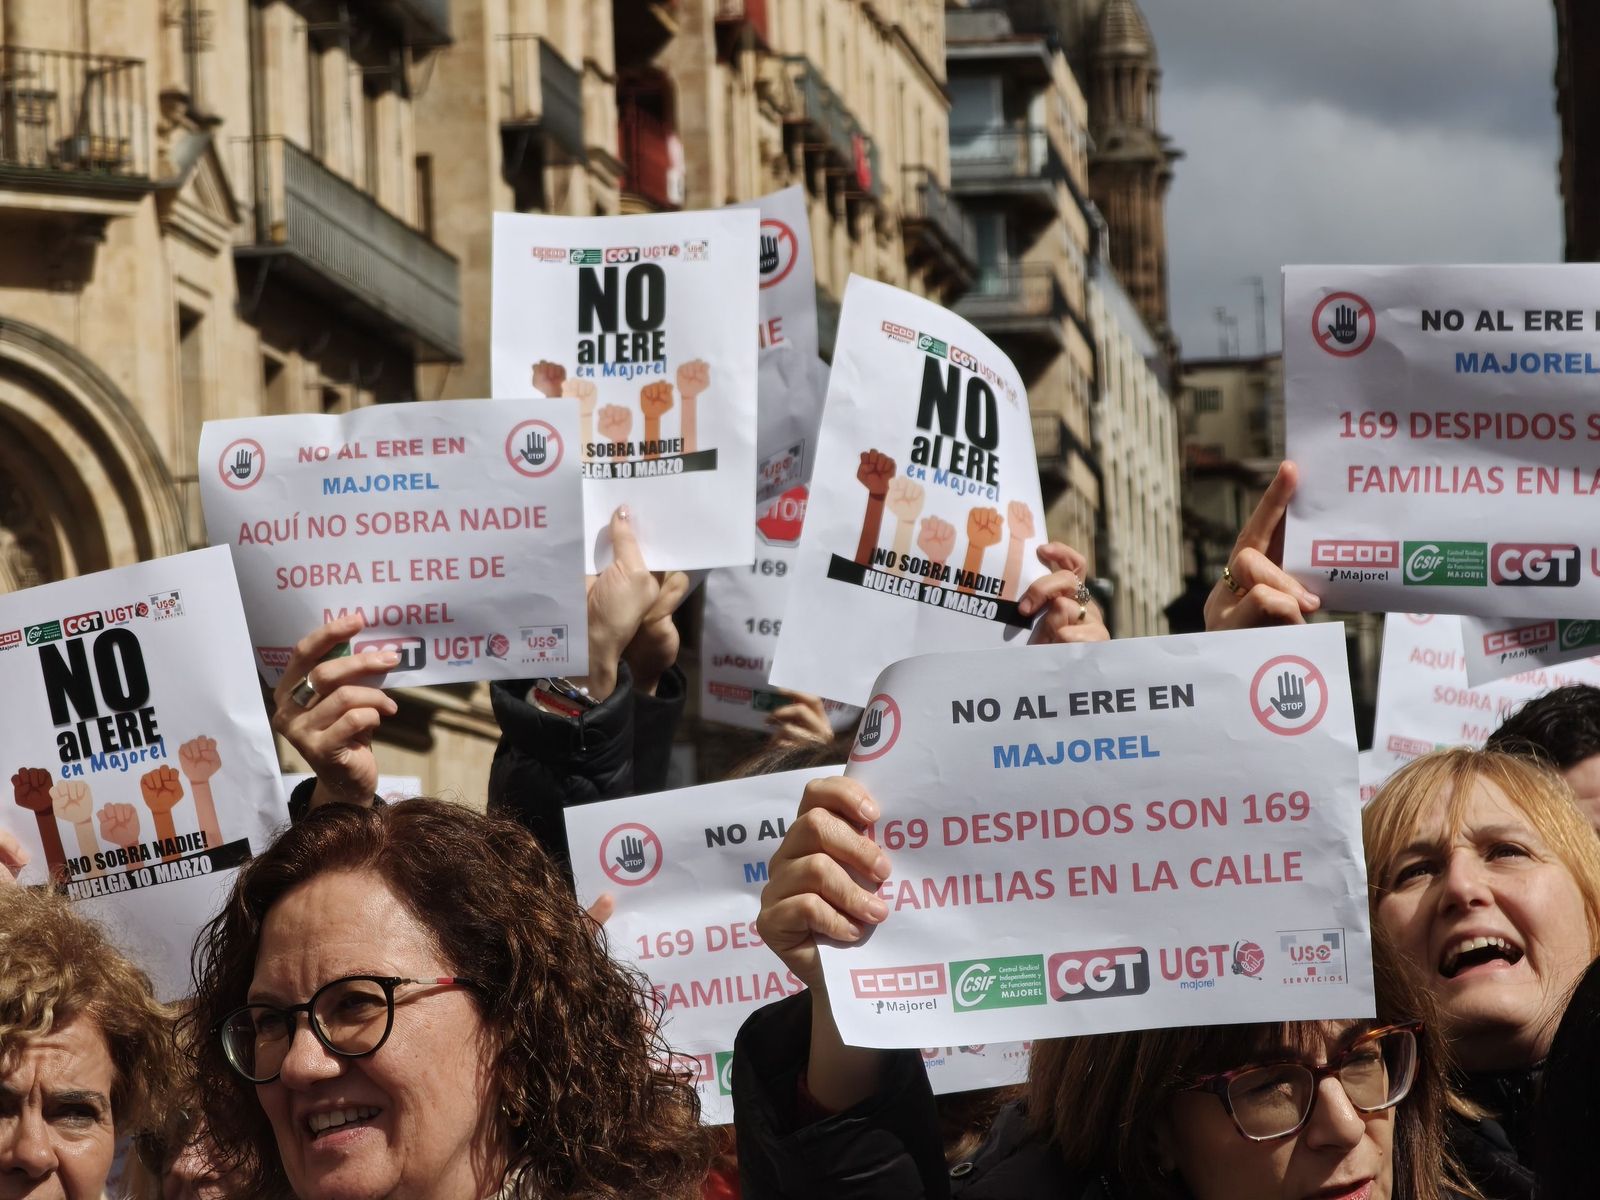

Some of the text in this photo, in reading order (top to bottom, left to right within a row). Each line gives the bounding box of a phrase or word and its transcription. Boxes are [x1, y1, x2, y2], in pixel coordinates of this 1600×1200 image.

[578, 263, 666, 334] NO
[1421, 310, 1464, 332] NO
[1474, 310, 1514, 332] AL
[1524, 310, 1584, 332] ERE
[577, 330, 666, 365] al ERE
[576, 356, 667, 380] en Majorel
[915, 355, 1000, 450] NO
[1339, 411, 1398, 440] 169
[1409, 411, 1577, 441] DESPIDOS
[298, 436, 466, 463] NO AL ERE EN
[586, 442, 635, 457] SOBRA
[910, 435, 1000, 487] al ERE
[615, 462, 632, 478] 10
[635, 457, 684, 477] MARZO
[1348, 465, 1504, 495] FAMILIAS
[1516, 467, 1559, 494] EN
[322, 472, 440, 495] MAJOREL
[906, 465, 1000, 502] en Majorel
[237, 506, 548, 546] AQUÍ NO SOBRA NADIE
[1317, 545, 1393, 562] CCOO
[1498, 549, 1575, 581] CGT
[276, 556, 506, 591] SOBRA EL ERE DE
[899, 553, 952, 582] SOBRA
[953, 568, 1006, 597] NADIE!
[1340, 570, 1389, 582] Majorel
[862, 569, 998, 620] HUELGA 10 MARZO
[66, 614, 100, 634] CGT
[105, 605, 134, 624] UGT
[434, 636, 484, 660] UGT
[38, 627, 151, 726] NO
[952, 684, 1195, 724] NO AL ERE EN
[1280, 700, 1303, 713] STOP
[1433, 686, 1492, 711] SOBRA
[56, 706, 162, 763] al ERE
[862, 731, 879, 742] STOP
[61, 736, 168, 779] en Majorel
[992, 735, 1160, 769] MAJOREL
[942, 803, 1134, 847] DESPIDOS
[1146, 796, 1228, 833] SON
[1242, 790, 1311, 824] 169
[94, 843, 152, 870] SOBRA
[152, 830, 209, 858] NADIE!
[704, 823, 747, 848] NO
[67, 854, 213, 901] HUELGA 10 MARZO
[624, 858, 643, 868] STOP
[1068, 864, 1118, 897] EN
[1131, 860, 1178, 892] LA
[1189, 851, 1304, 888] CALLE
[636, 929, 694, 960] 169
[1290, 944, 1331, 962] USO
[1056, 954, 1146, 995] CGT
[1159, 944, 1230, 981] UGT
[856, 970, 939, 993] CCOO
[1001, 989, 1043, 999] MAJOREL
[1180, 978, 1215, 990] majorel
[1283, 975, 1343, 984] SERVICIOS
[886, 998, 937, 1014] Majorel
